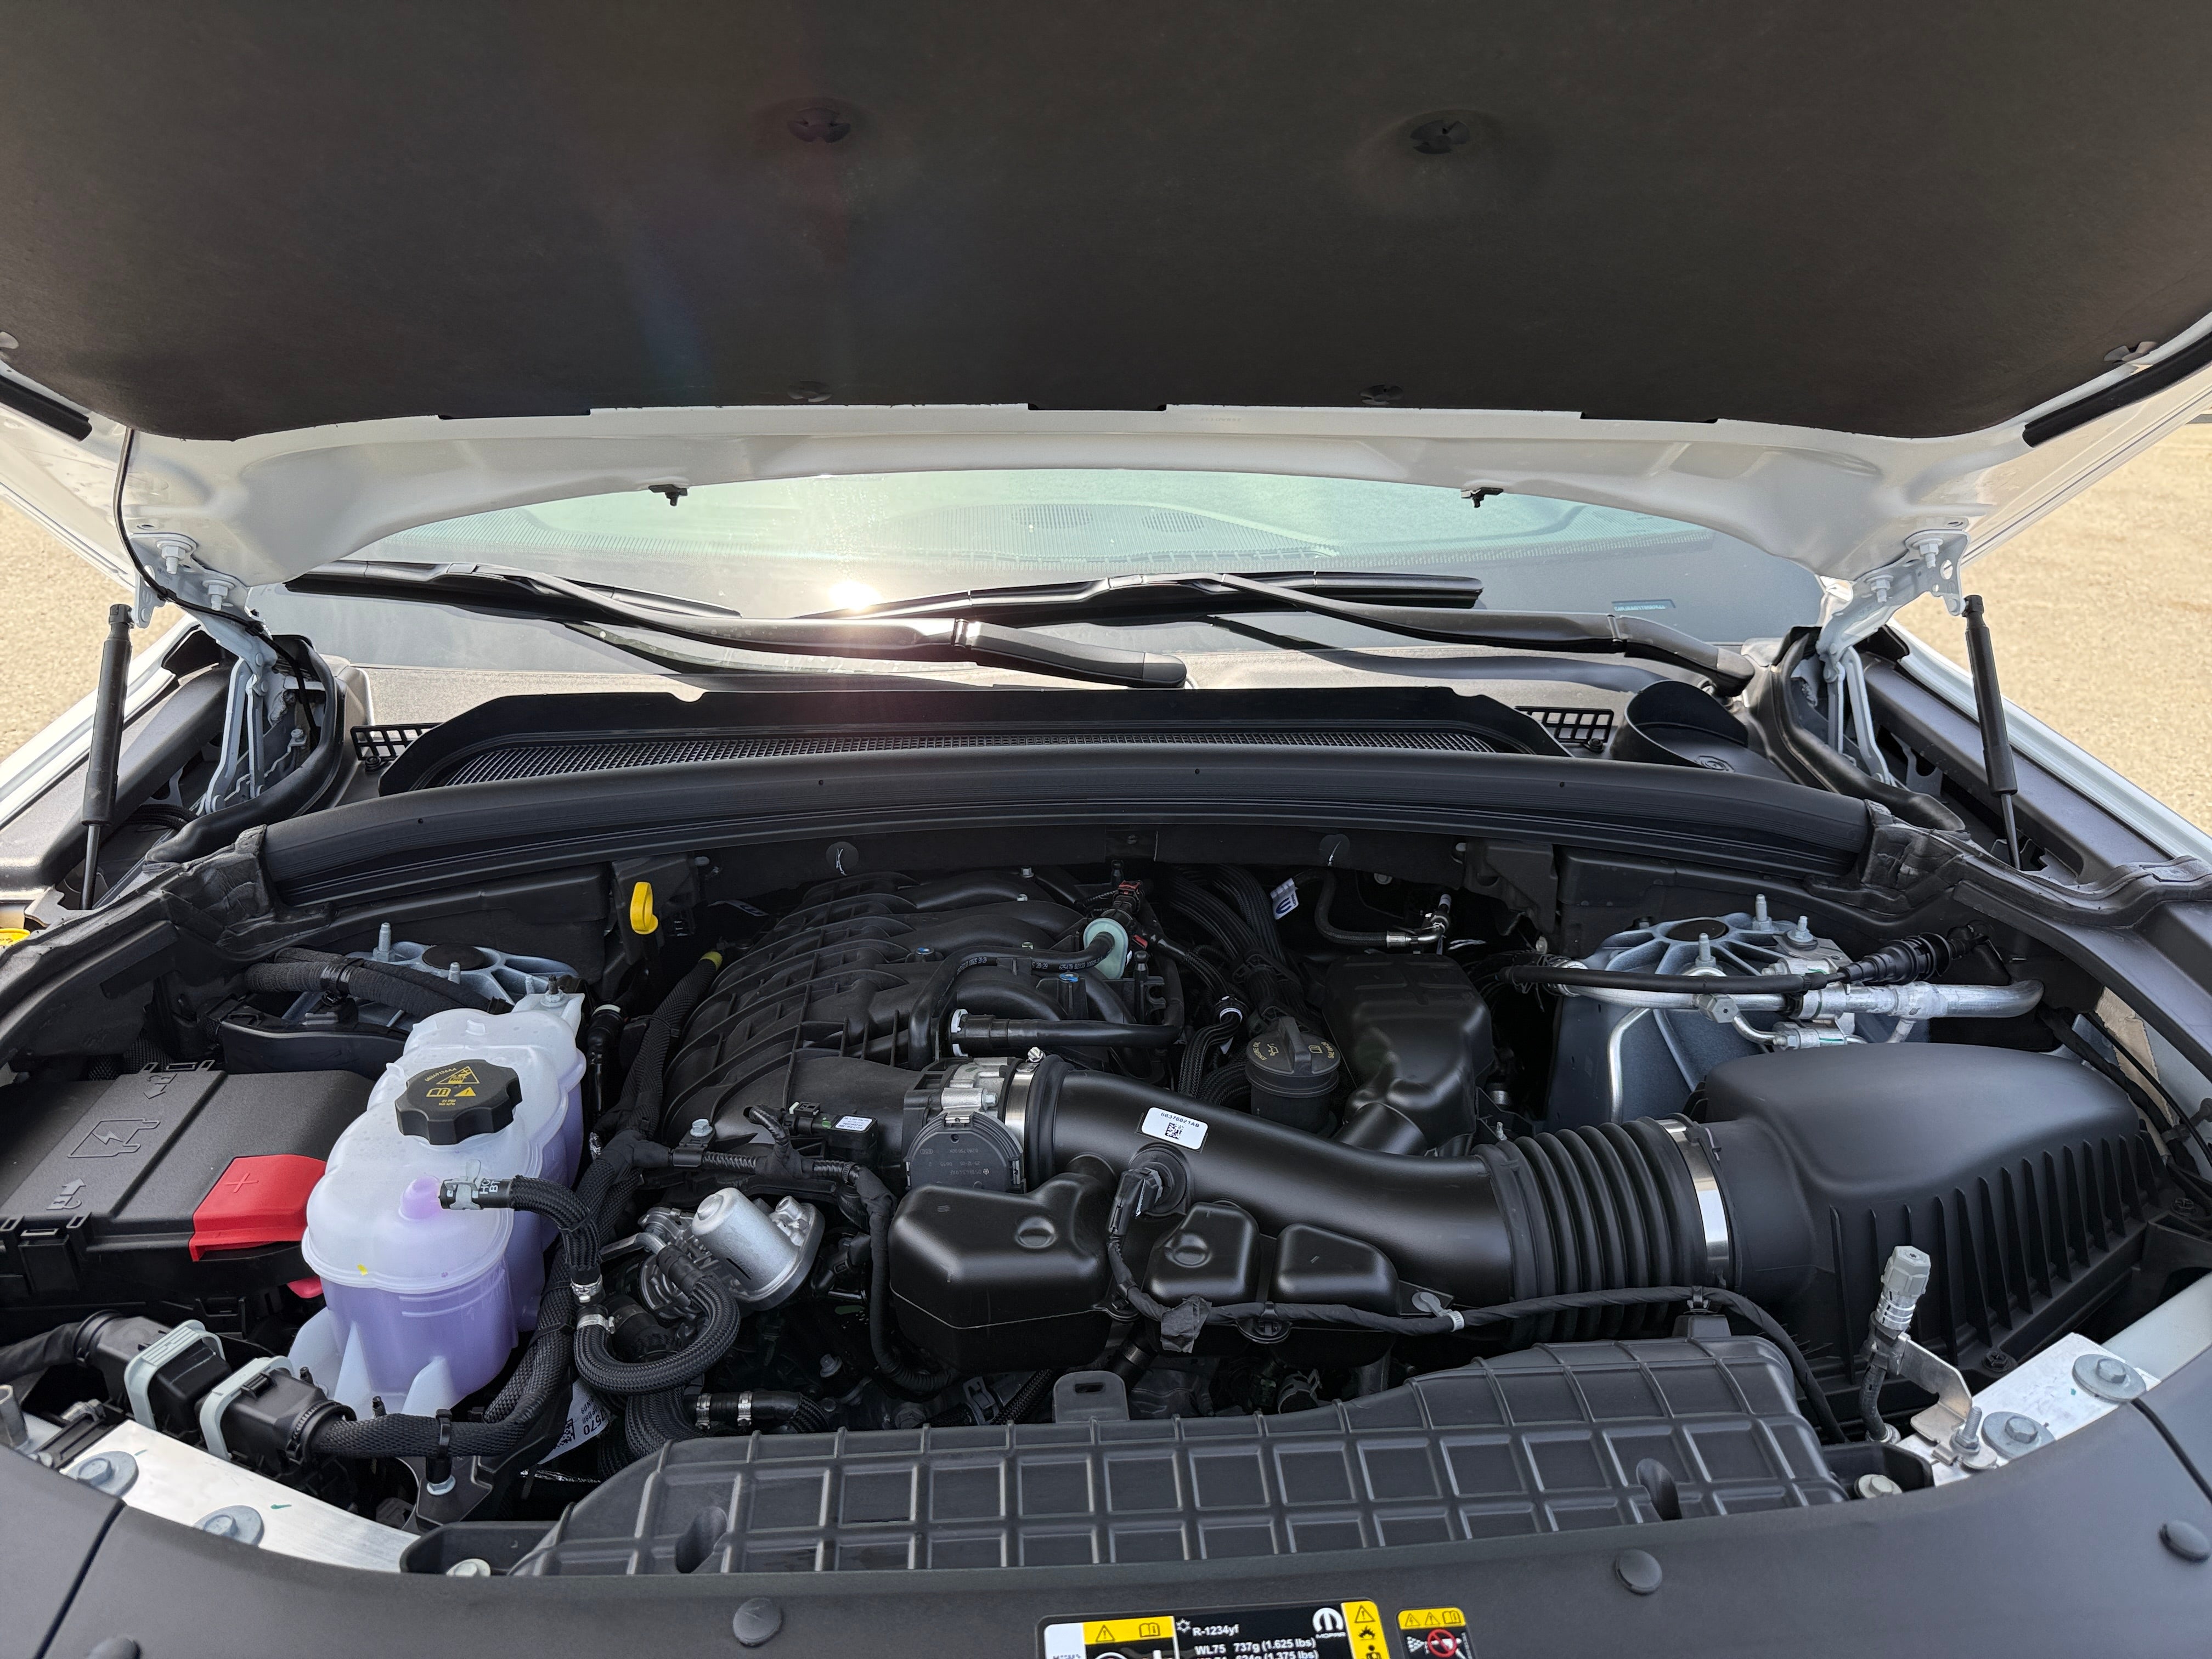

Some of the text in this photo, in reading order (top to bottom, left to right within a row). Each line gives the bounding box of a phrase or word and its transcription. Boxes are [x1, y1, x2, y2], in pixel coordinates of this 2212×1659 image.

[1192, 1624, 1240, 1637] R-1234yf
[1194, 1637, 1317, 1655] WL75 737g (1.625 lbs)
